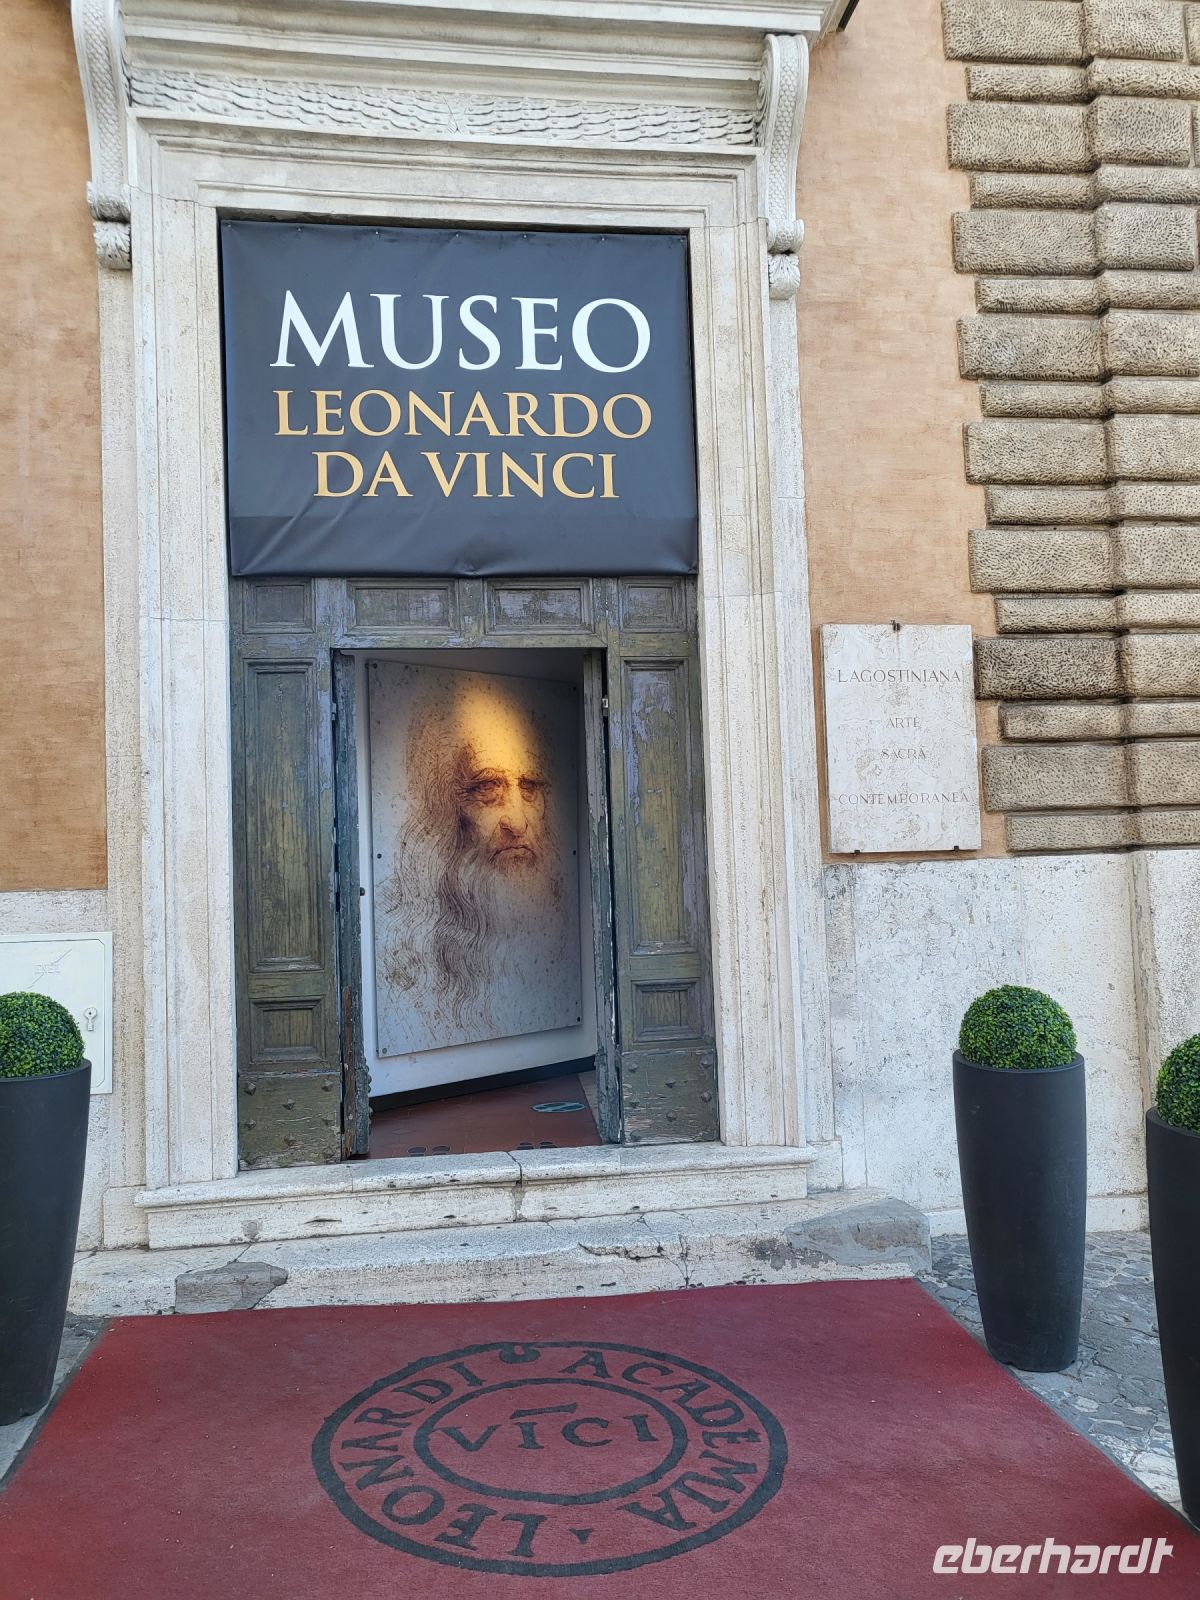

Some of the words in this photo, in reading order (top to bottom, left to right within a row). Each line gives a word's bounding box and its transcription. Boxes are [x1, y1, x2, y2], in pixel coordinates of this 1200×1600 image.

[269, 289, 651, 374] MUSEO
[272, 388, 653, 440] LEONARDO
[311, 450, 414, 499] DA
[420, 451, 620, 500] VINCI
[886, 717, 921, 729] ARTE
[881, 748, 927, 760] SACRA
[838, 792, 970, 805] CONTEMPORANEA
[338, 1361, 549, 1558] LEONARDI
